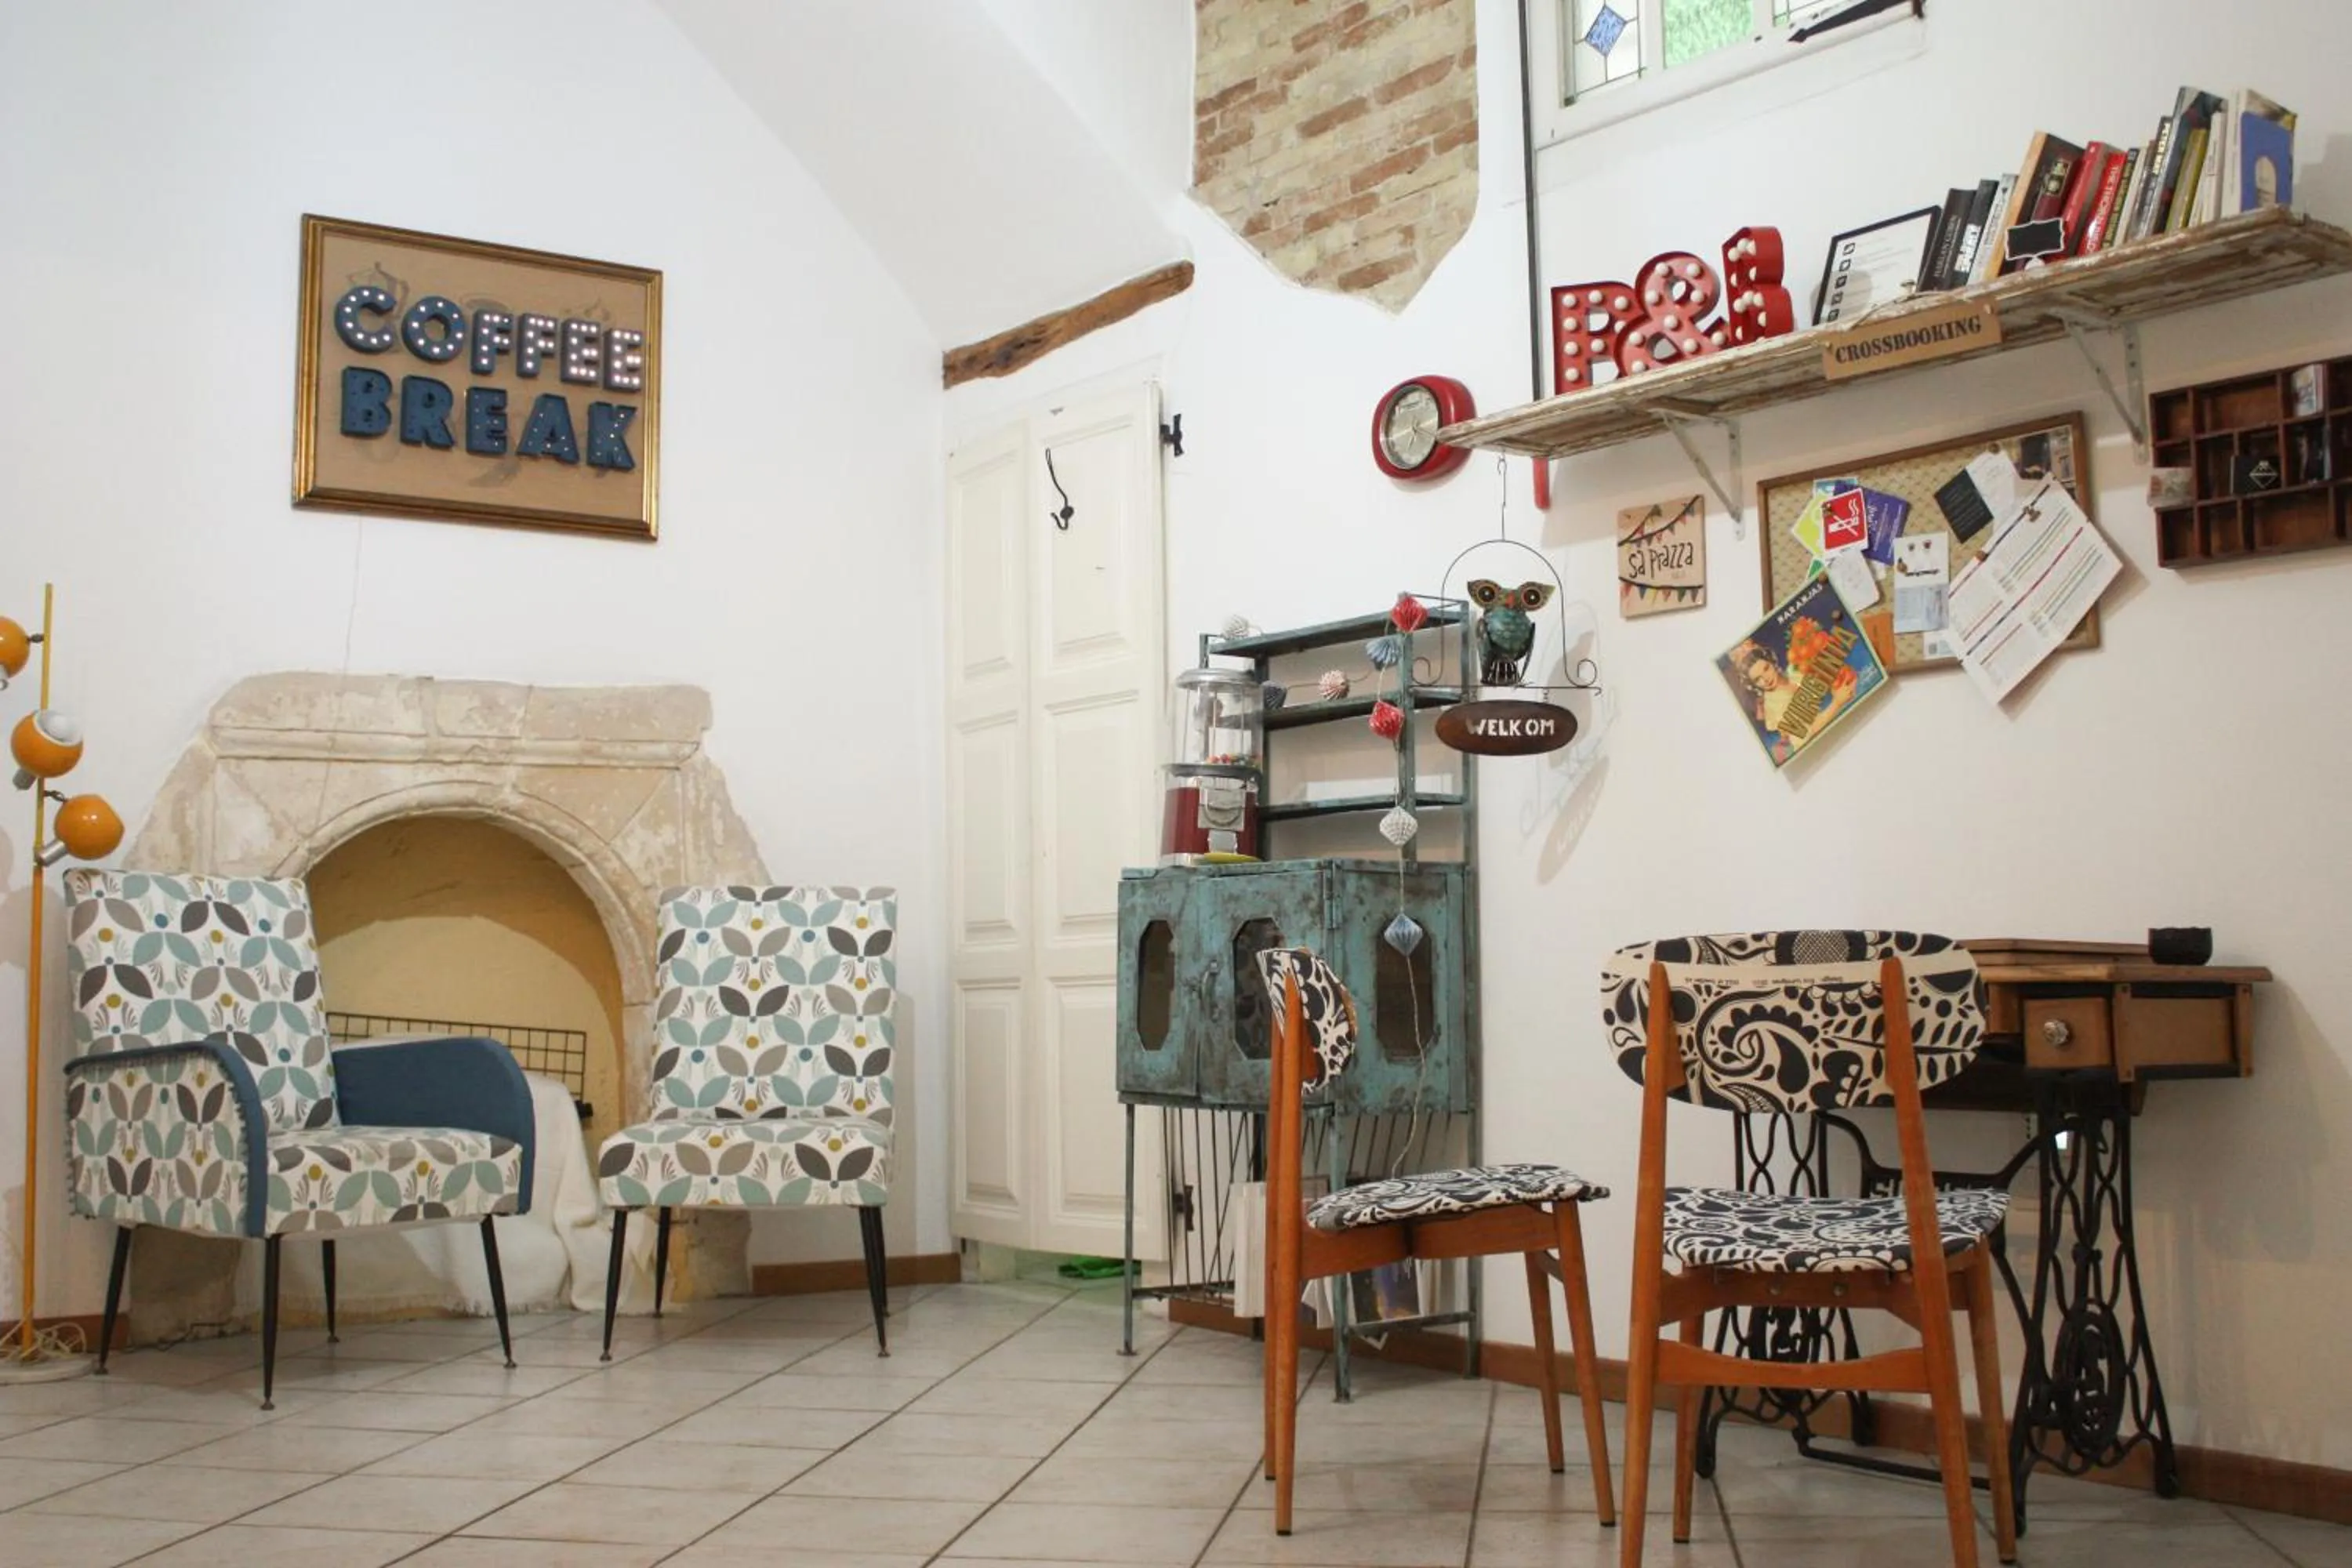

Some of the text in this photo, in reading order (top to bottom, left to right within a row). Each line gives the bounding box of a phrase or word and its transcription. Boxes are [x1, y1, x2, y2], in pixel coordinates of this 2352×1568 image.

[335, 285, 644, 391] COFFEE
[1835, 315, 1982, 364] CROSSBOOKING
[340, 366, 638, 470] BREAK
[1465, 717, 1555, 737] WELKOM
[1777, 626, 1859, 739] VIRGINIA
